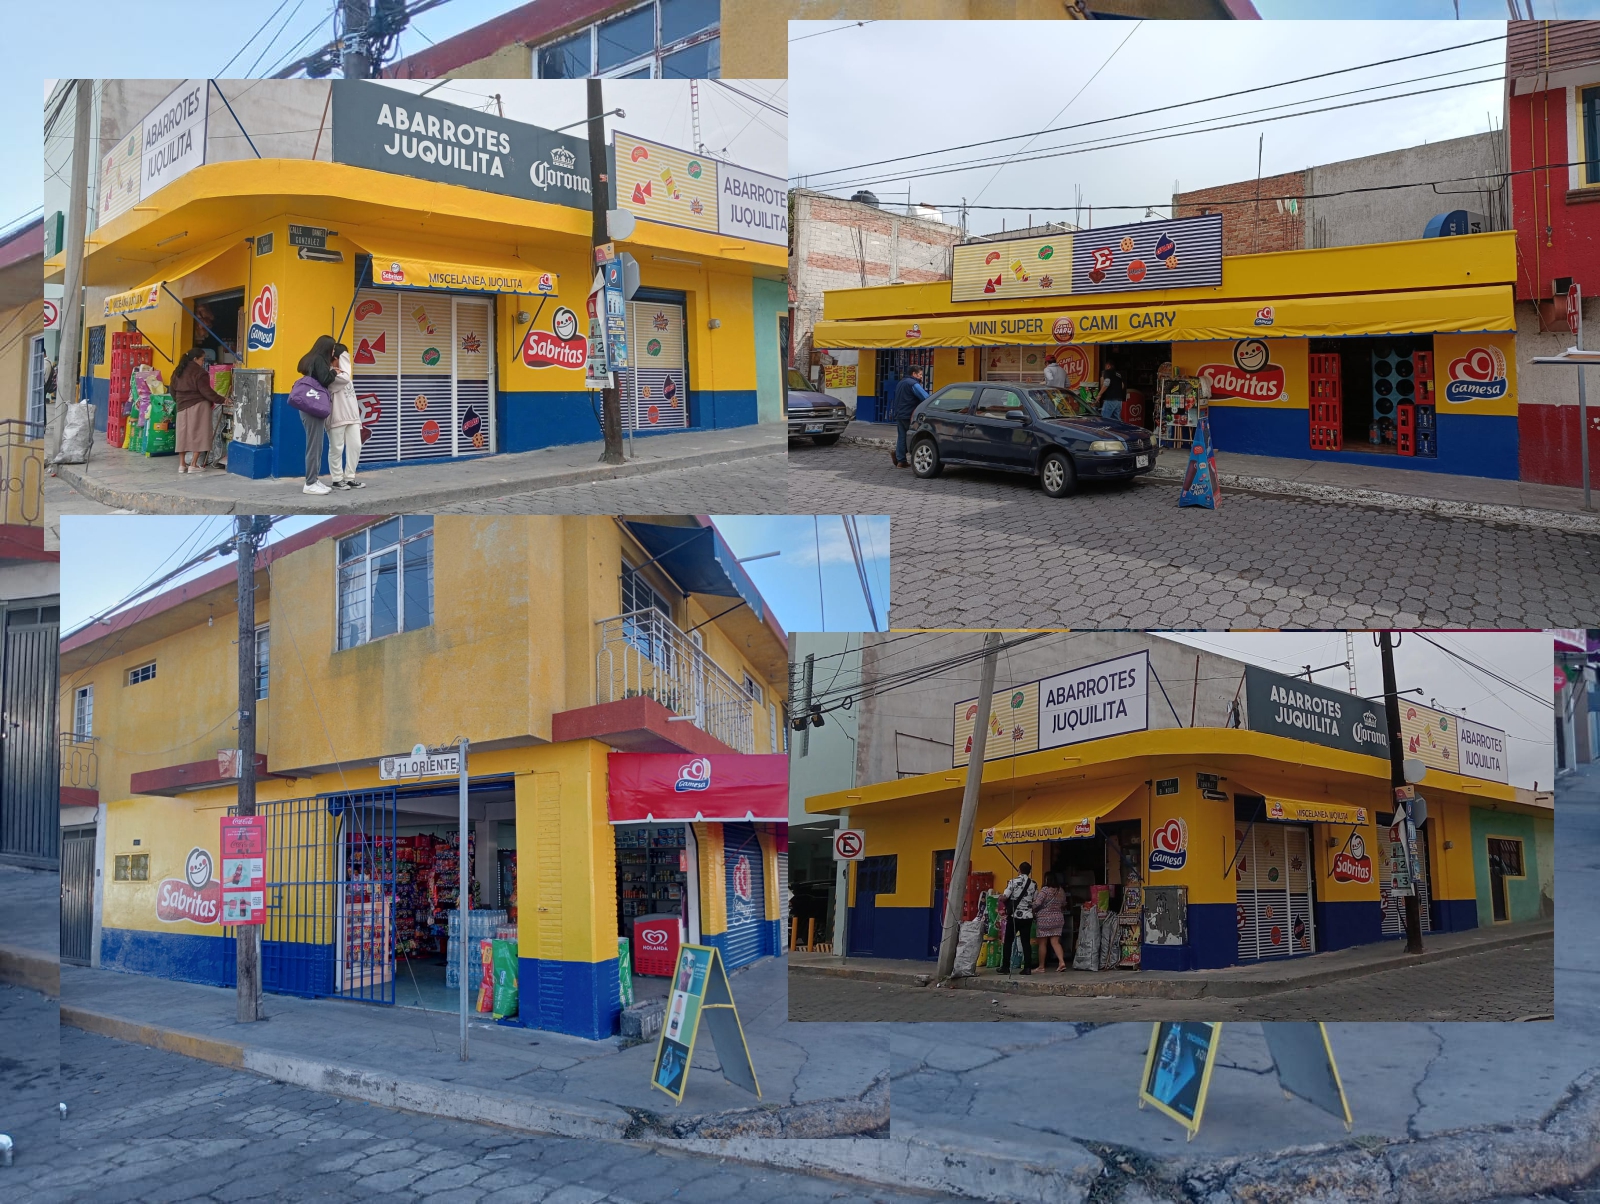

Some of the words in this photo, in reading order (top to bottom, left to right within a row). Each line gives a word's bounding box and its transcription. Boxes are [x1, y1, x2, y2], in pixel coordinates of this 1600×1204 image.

[145, 85, 201, 151] ABARROTES
[376, 102, 511, 155] ABARROTES
[147, 128, 193, 181] JUQUILITA
[383, 132, 505, 179] JUQUILITA
[529, 159, 593, 195] Corona
[723, 176, 788, 209] ABARROTE
[731, 204, 788, 233] JUQUILITA
[290, 226, 302, 235] CALLE
[312, 229, 326, 237] DANIEL
[295, 236, 320, 246] GONZALEZ
[382, 271, 404, 282] Sabritas
[429, 273, 487, 286] MISCELANEA
[969, 320, 997, 336] MINI
[1000, 318, 1043, 334] SUPER
[1053, 327, 1073, 335] GARY
[1079, 314, 1118, 332] CAMI
[1129, 311, 1176, 329] GARY
[250, 327, 273, 344] Gamesa
[527, 333, 584, 365] Sabritas
[1062, 358, 1084, 376] ARY
[1203, 368, 1278, 396] Sabritas
[1451, 383, 1501, 395] Gamesa
[1045, 668, 1136, 708] ABARROTES
[1270, 685, 1342, 719] ABARROTES
[1052, 698, 1128, 734] JUQUILITA
[1275, 706, 1340, 738] JUQUILITA
[1352, 721, 1388, 746] Corona
[1460, 728, 1503, 754] ABARROTES
[398, 763, 407, 774] 11
[412, 758, 457, 773] ORIENTE
[1466, 748, 1501, 772] JUQUILITA
[678, 779, 707, 790] Gamesa
[1003, 829, 1037, 840] MISCELANEA
[1152, 852, 1183, 866] Gamesa
[1336, 856, 1369, 879] Sabritas
[160, 884, 217, 918] Sabritas
